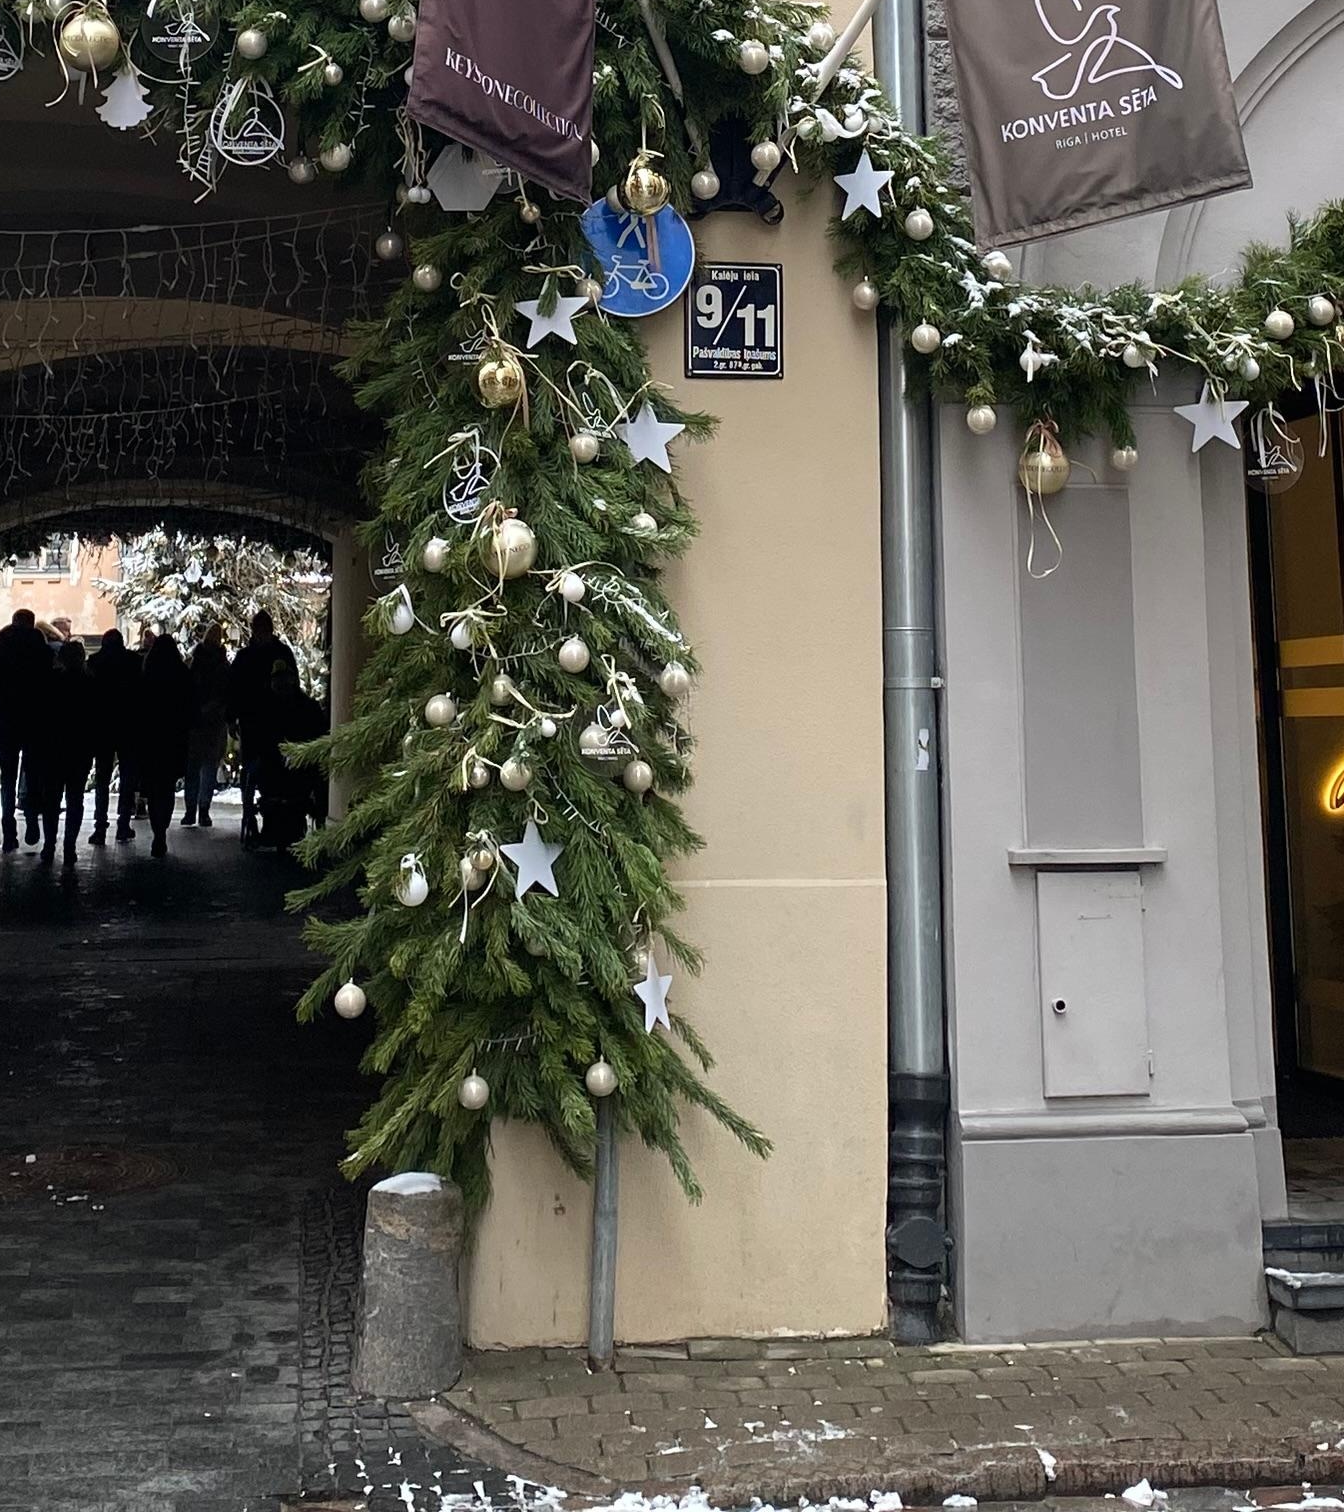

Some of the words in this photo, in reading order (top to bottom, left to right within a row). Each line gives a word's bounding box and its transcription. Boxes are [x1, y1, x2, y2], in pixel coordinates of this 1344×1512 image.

[1000, 100, 1115, 143] KONVENTA
[1118, 85, 1158, 116] SĒTA
[1091, 126, 1128, 142] HOTEL
[711, 269, 739, 283] Kalēju
[695, 284, 775, 348] 9/11
